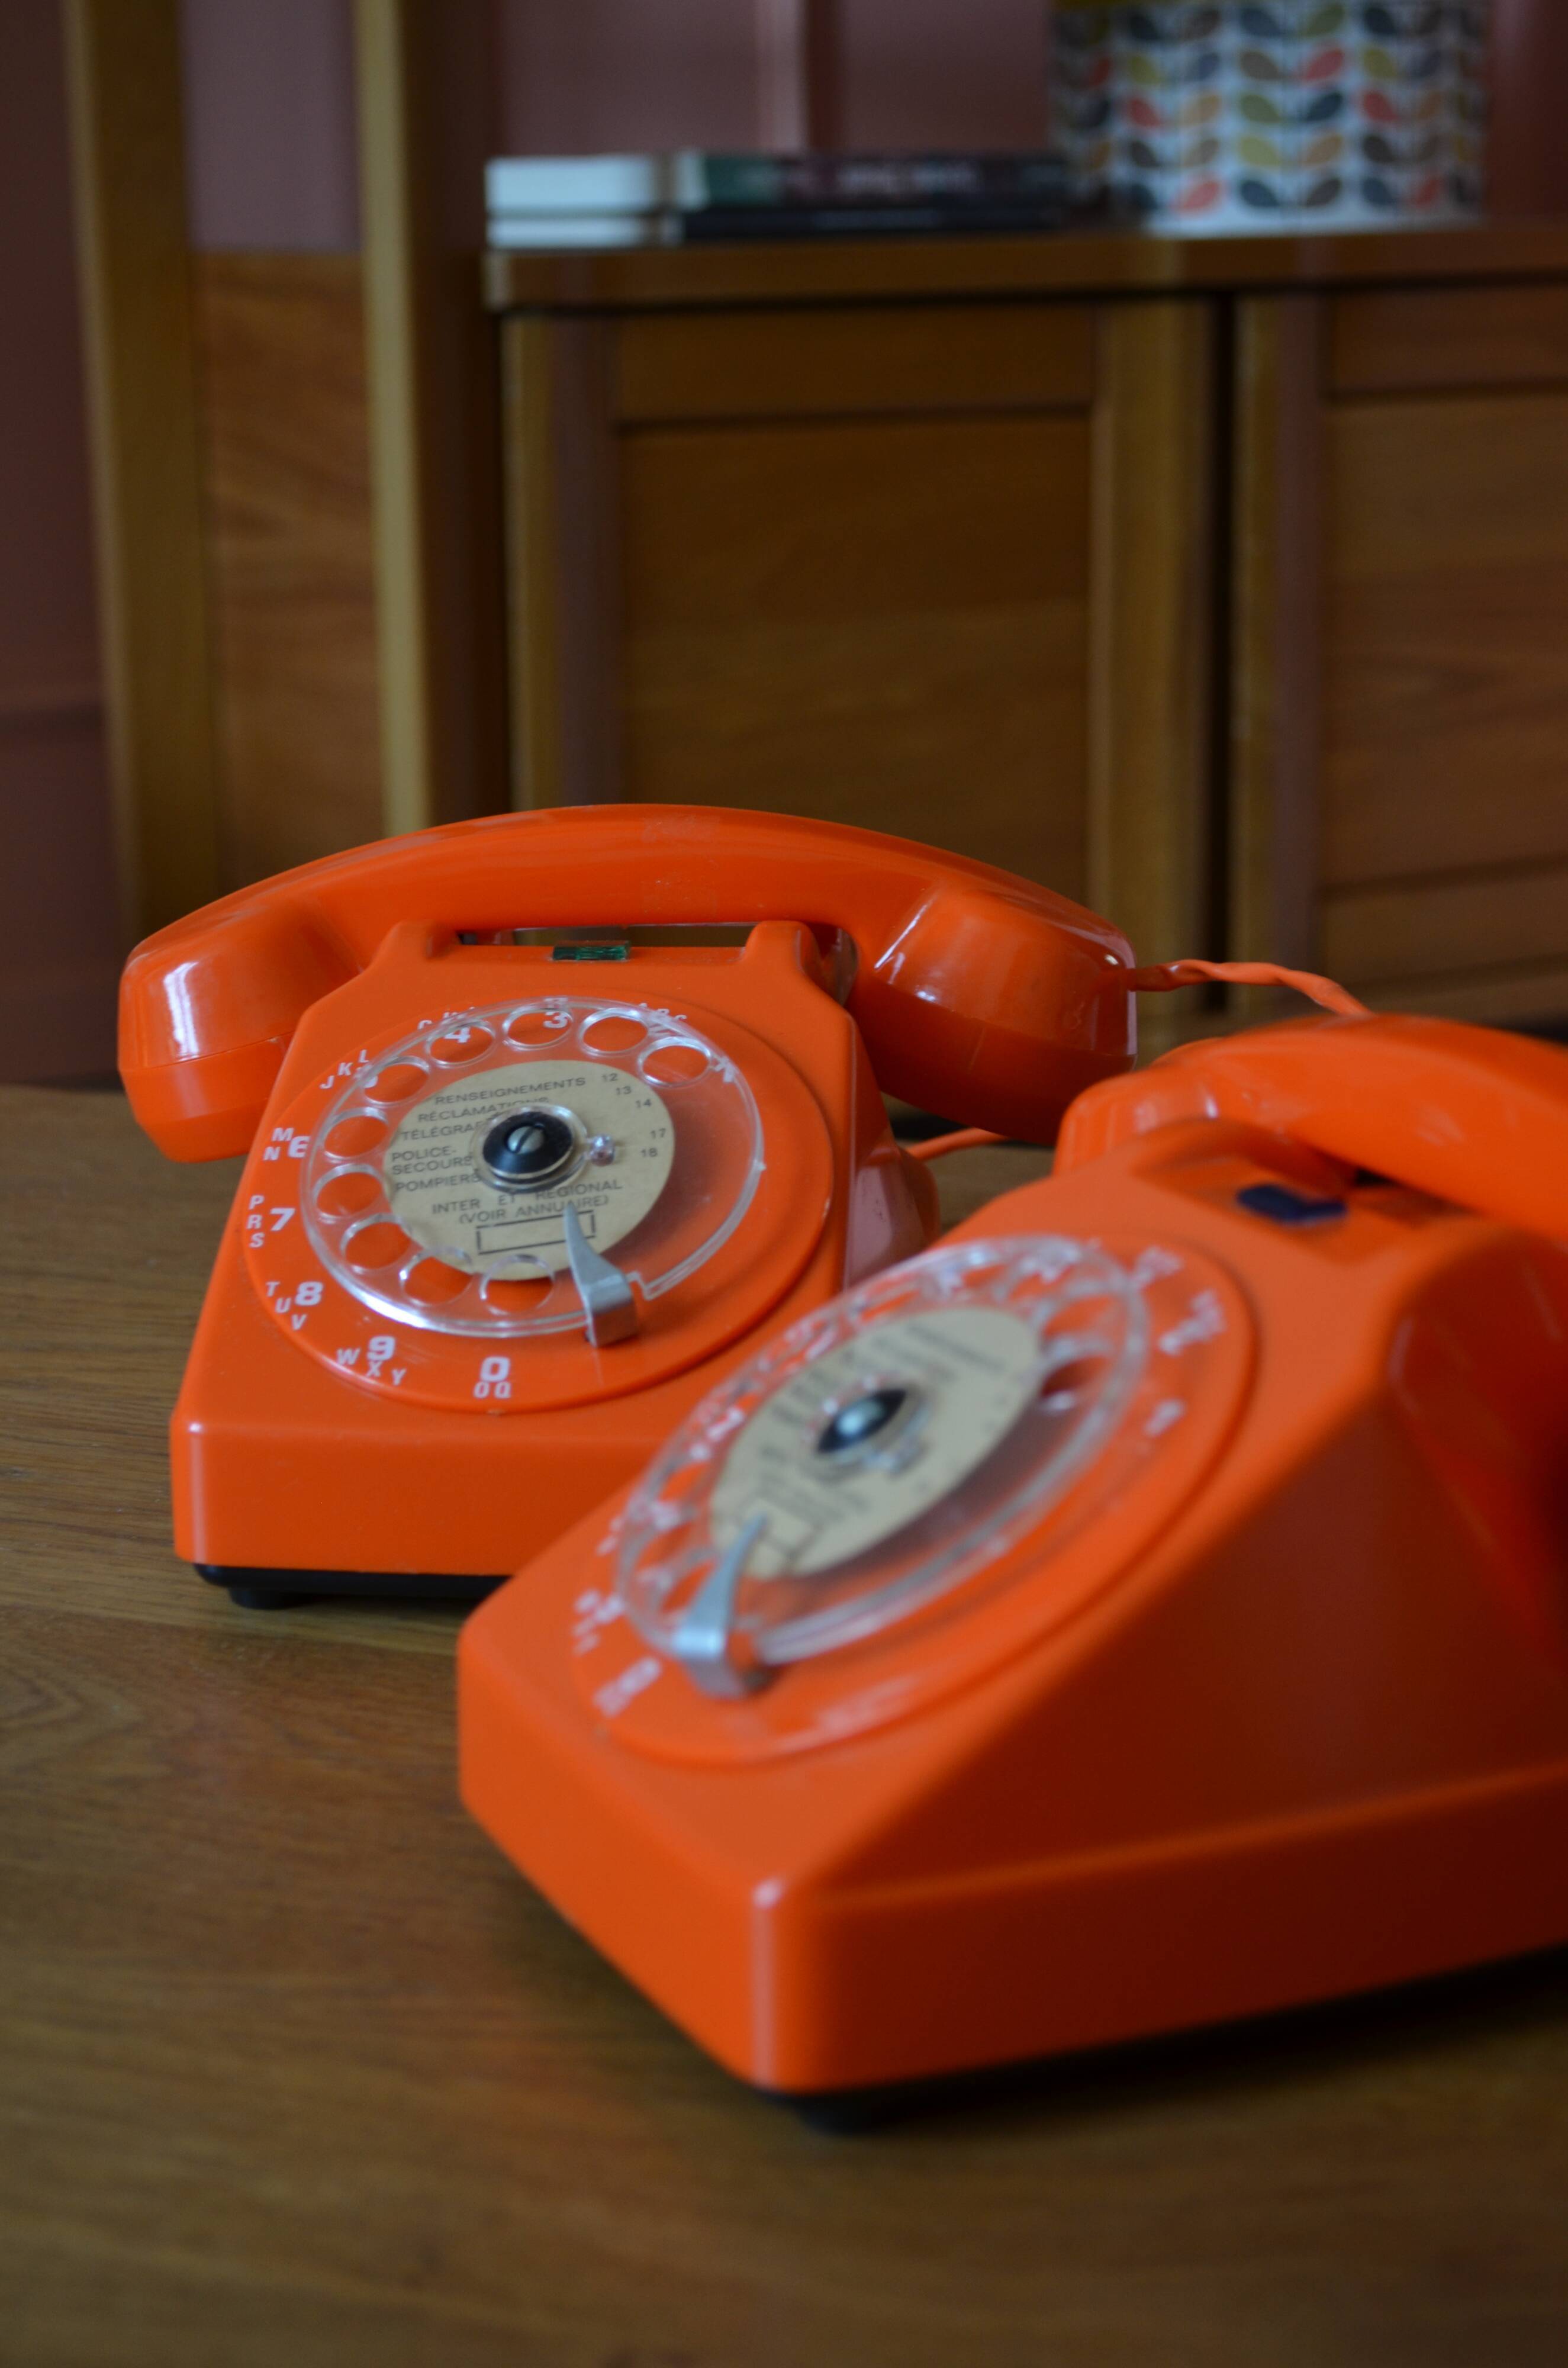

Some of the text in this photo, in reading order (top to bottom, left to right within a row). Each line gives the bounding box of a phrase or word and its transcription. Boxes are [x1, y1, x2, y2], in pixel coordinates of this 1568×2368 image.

[435, 1073, 619, 1105] RENSEIGNEMENTS 12
[418, 1086, 632, 1122] RÉCLAMATIS 13
[635, 1099, 652, 1108] 14
[651, 1128, 666, 1138] 17
[391, 1146, 456, 1162] POLICE-
[641, 1148, 658, 1157] 18
[432, 1198, 481, 1214] INTER
[498, 1193, 516, 1205] ET
[271, 1207, 295, 1231] 7
[459, 1209, 507, 1224] (VOIR
[296, 1281, 323, 1306] 8
[368, 1336, 395, 1361] 9
